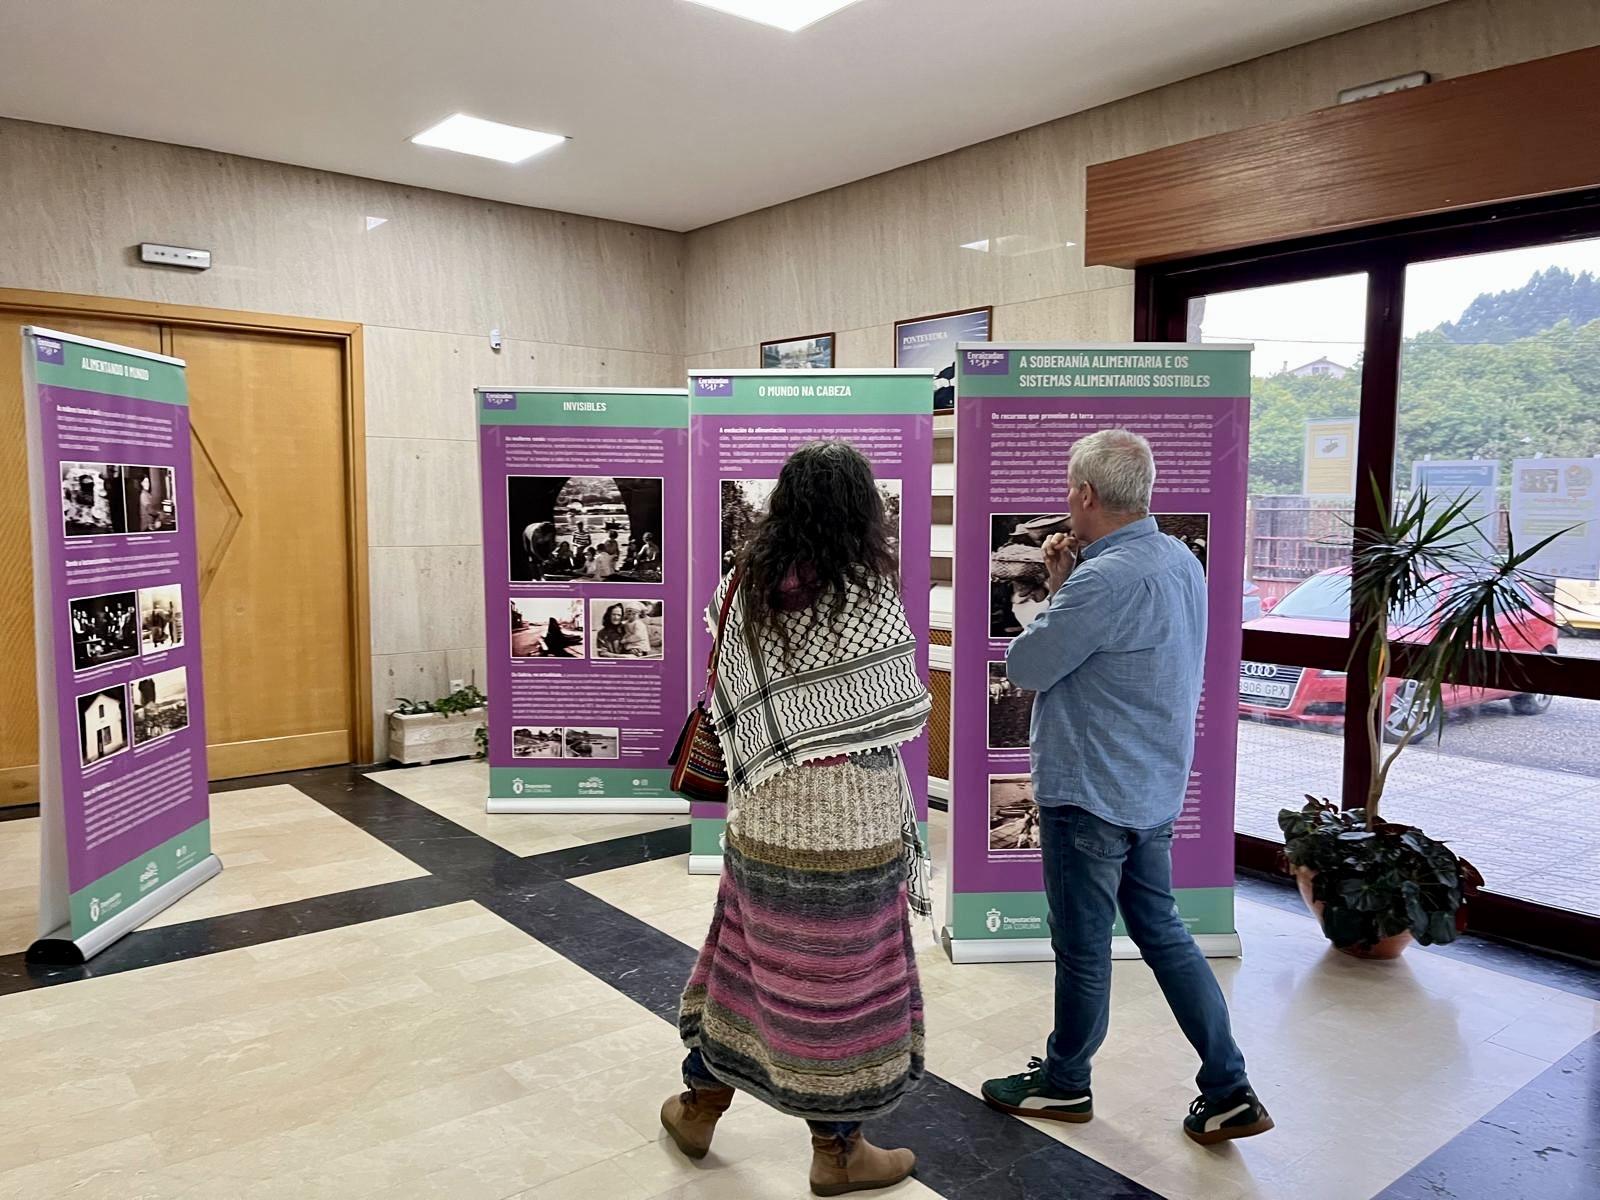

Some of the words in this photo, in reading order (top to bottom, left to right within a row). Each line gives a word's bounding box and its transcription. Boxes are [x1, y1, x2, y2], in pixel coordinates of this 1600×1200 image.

[1019, 356, 1028, 368] A
[1030, 353, 1090, 368] SOBERANÍA
[1091, 355, 1162, 368] ALIMENTARIA
[1164, 356, 1172, 368] E
[1174, 356, 1189, 368] OS
[1019, 374, 1072, 387] SISTEMAS
[1073, 374, 1151, 387] ALIMENTARIOS
[1152, 375, 1211, 388] SOSTIBLES
[759, 386, 765, 397] O
[767, 386, 799, 397] MUNDO
[801, 386, 815, 397] NA
[816, 386, 852, 397] CABEZA
[563, 402, 607, 411] INVISIBLES
[1265, 684, 1286, 697] GPX
